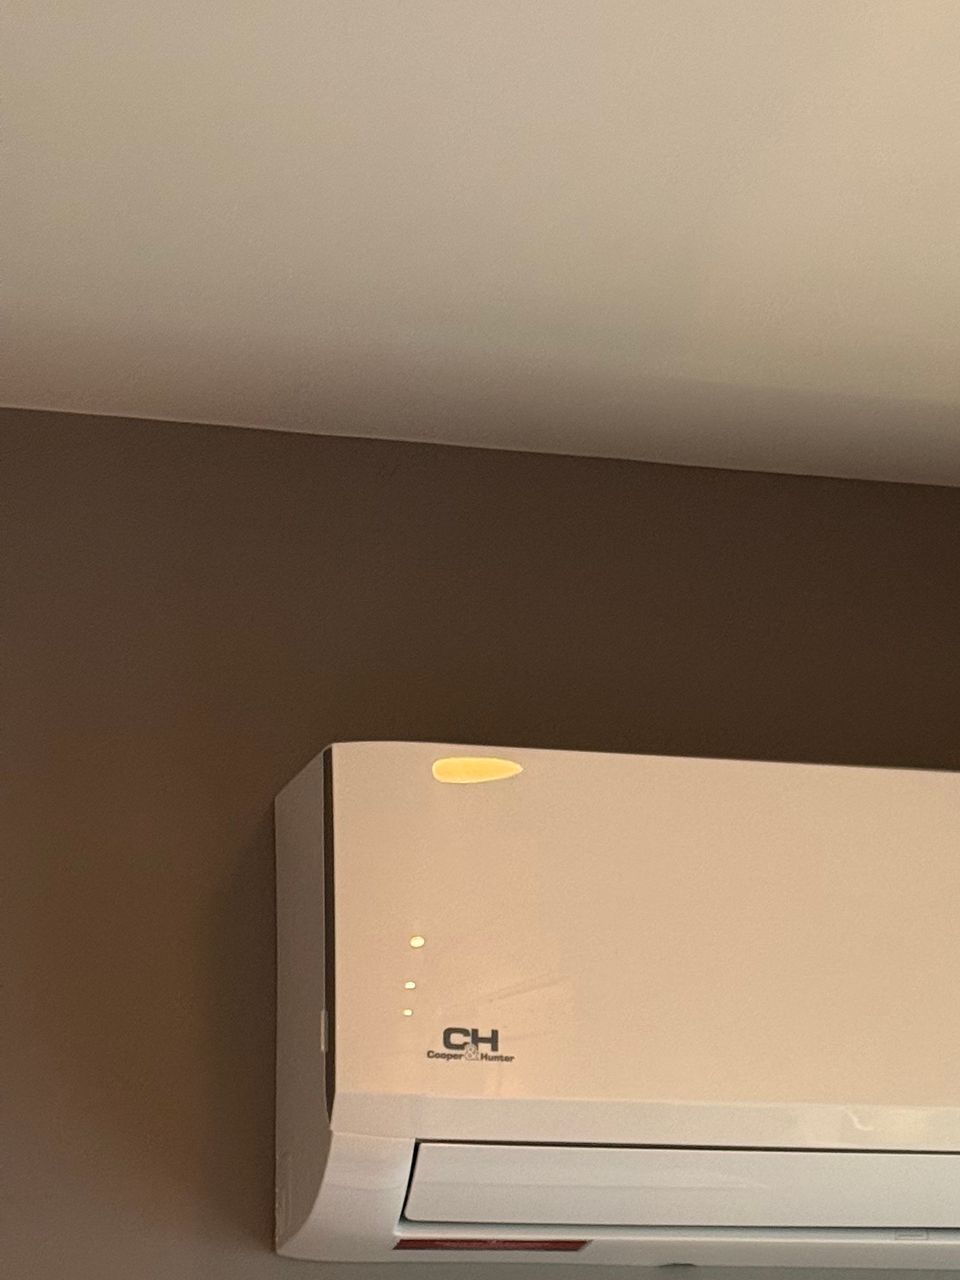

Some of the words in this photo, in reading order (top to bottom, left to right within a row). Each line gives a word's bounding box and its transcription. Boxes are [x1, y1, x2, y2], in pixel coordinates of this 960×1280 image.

[443, 1027, 499, 1052] CH
[427, 1050, 463, 1061] Cooper
[480, 1052, 515, 1063] Hunter
